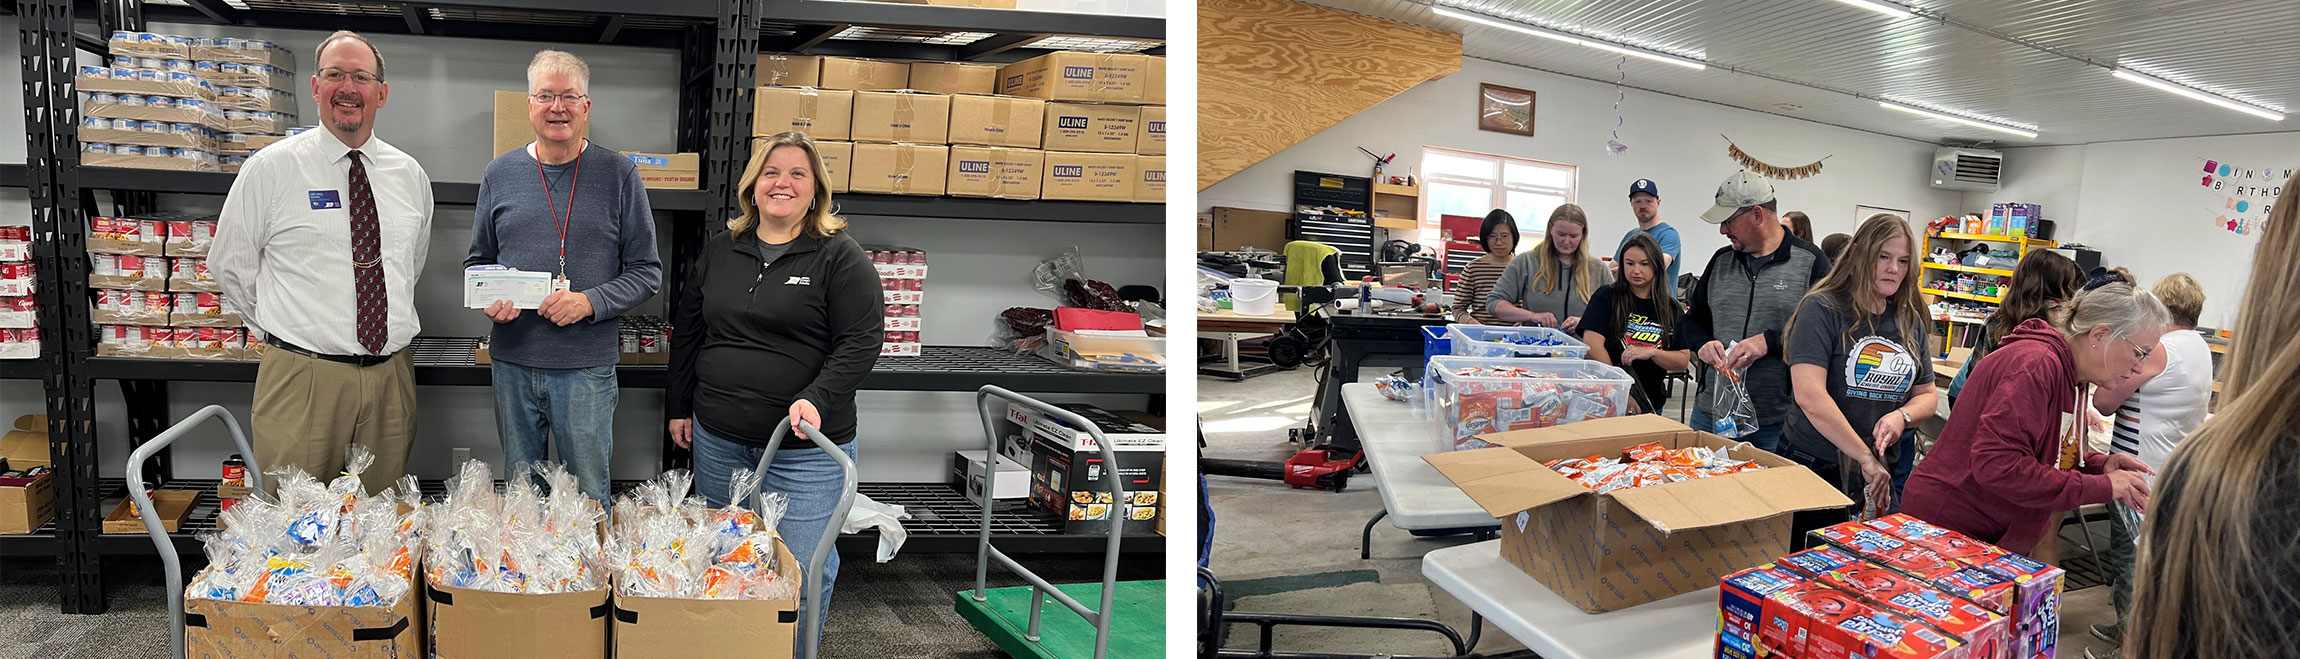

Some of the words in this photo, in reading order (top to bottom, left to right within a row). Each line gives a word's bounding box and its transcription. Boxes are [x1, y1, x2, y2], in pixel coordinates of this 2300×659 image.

[1066, 68, 1092, 78] ULINE
[1007, 76, 1024, 88] ULINE
[1060, 118, 1086, 128] ULINE
[1150, 123, 1166, 132] ULI
[961, 162, 988, 172] ULINE
[1733, 148, 1820, 177] THANKFUL
[1055, 167, 1081, 175] ULINE
[1146, 171, 1166, 180] ULIN
[1632, 331, 1660, 342] 100
[1864, 373, 1901, 385] ROYAL
[1846, 389, 1867, 397] GIVING
[1010, 408, 1028, 424] T-fal
[1032, 418, 1050, 432] Ultimate
[1058, 430, 1072, 440] Clean
[1840, 619, 1903, 646] Kool-Aid
[1742, 642, 1750, 653] 20
